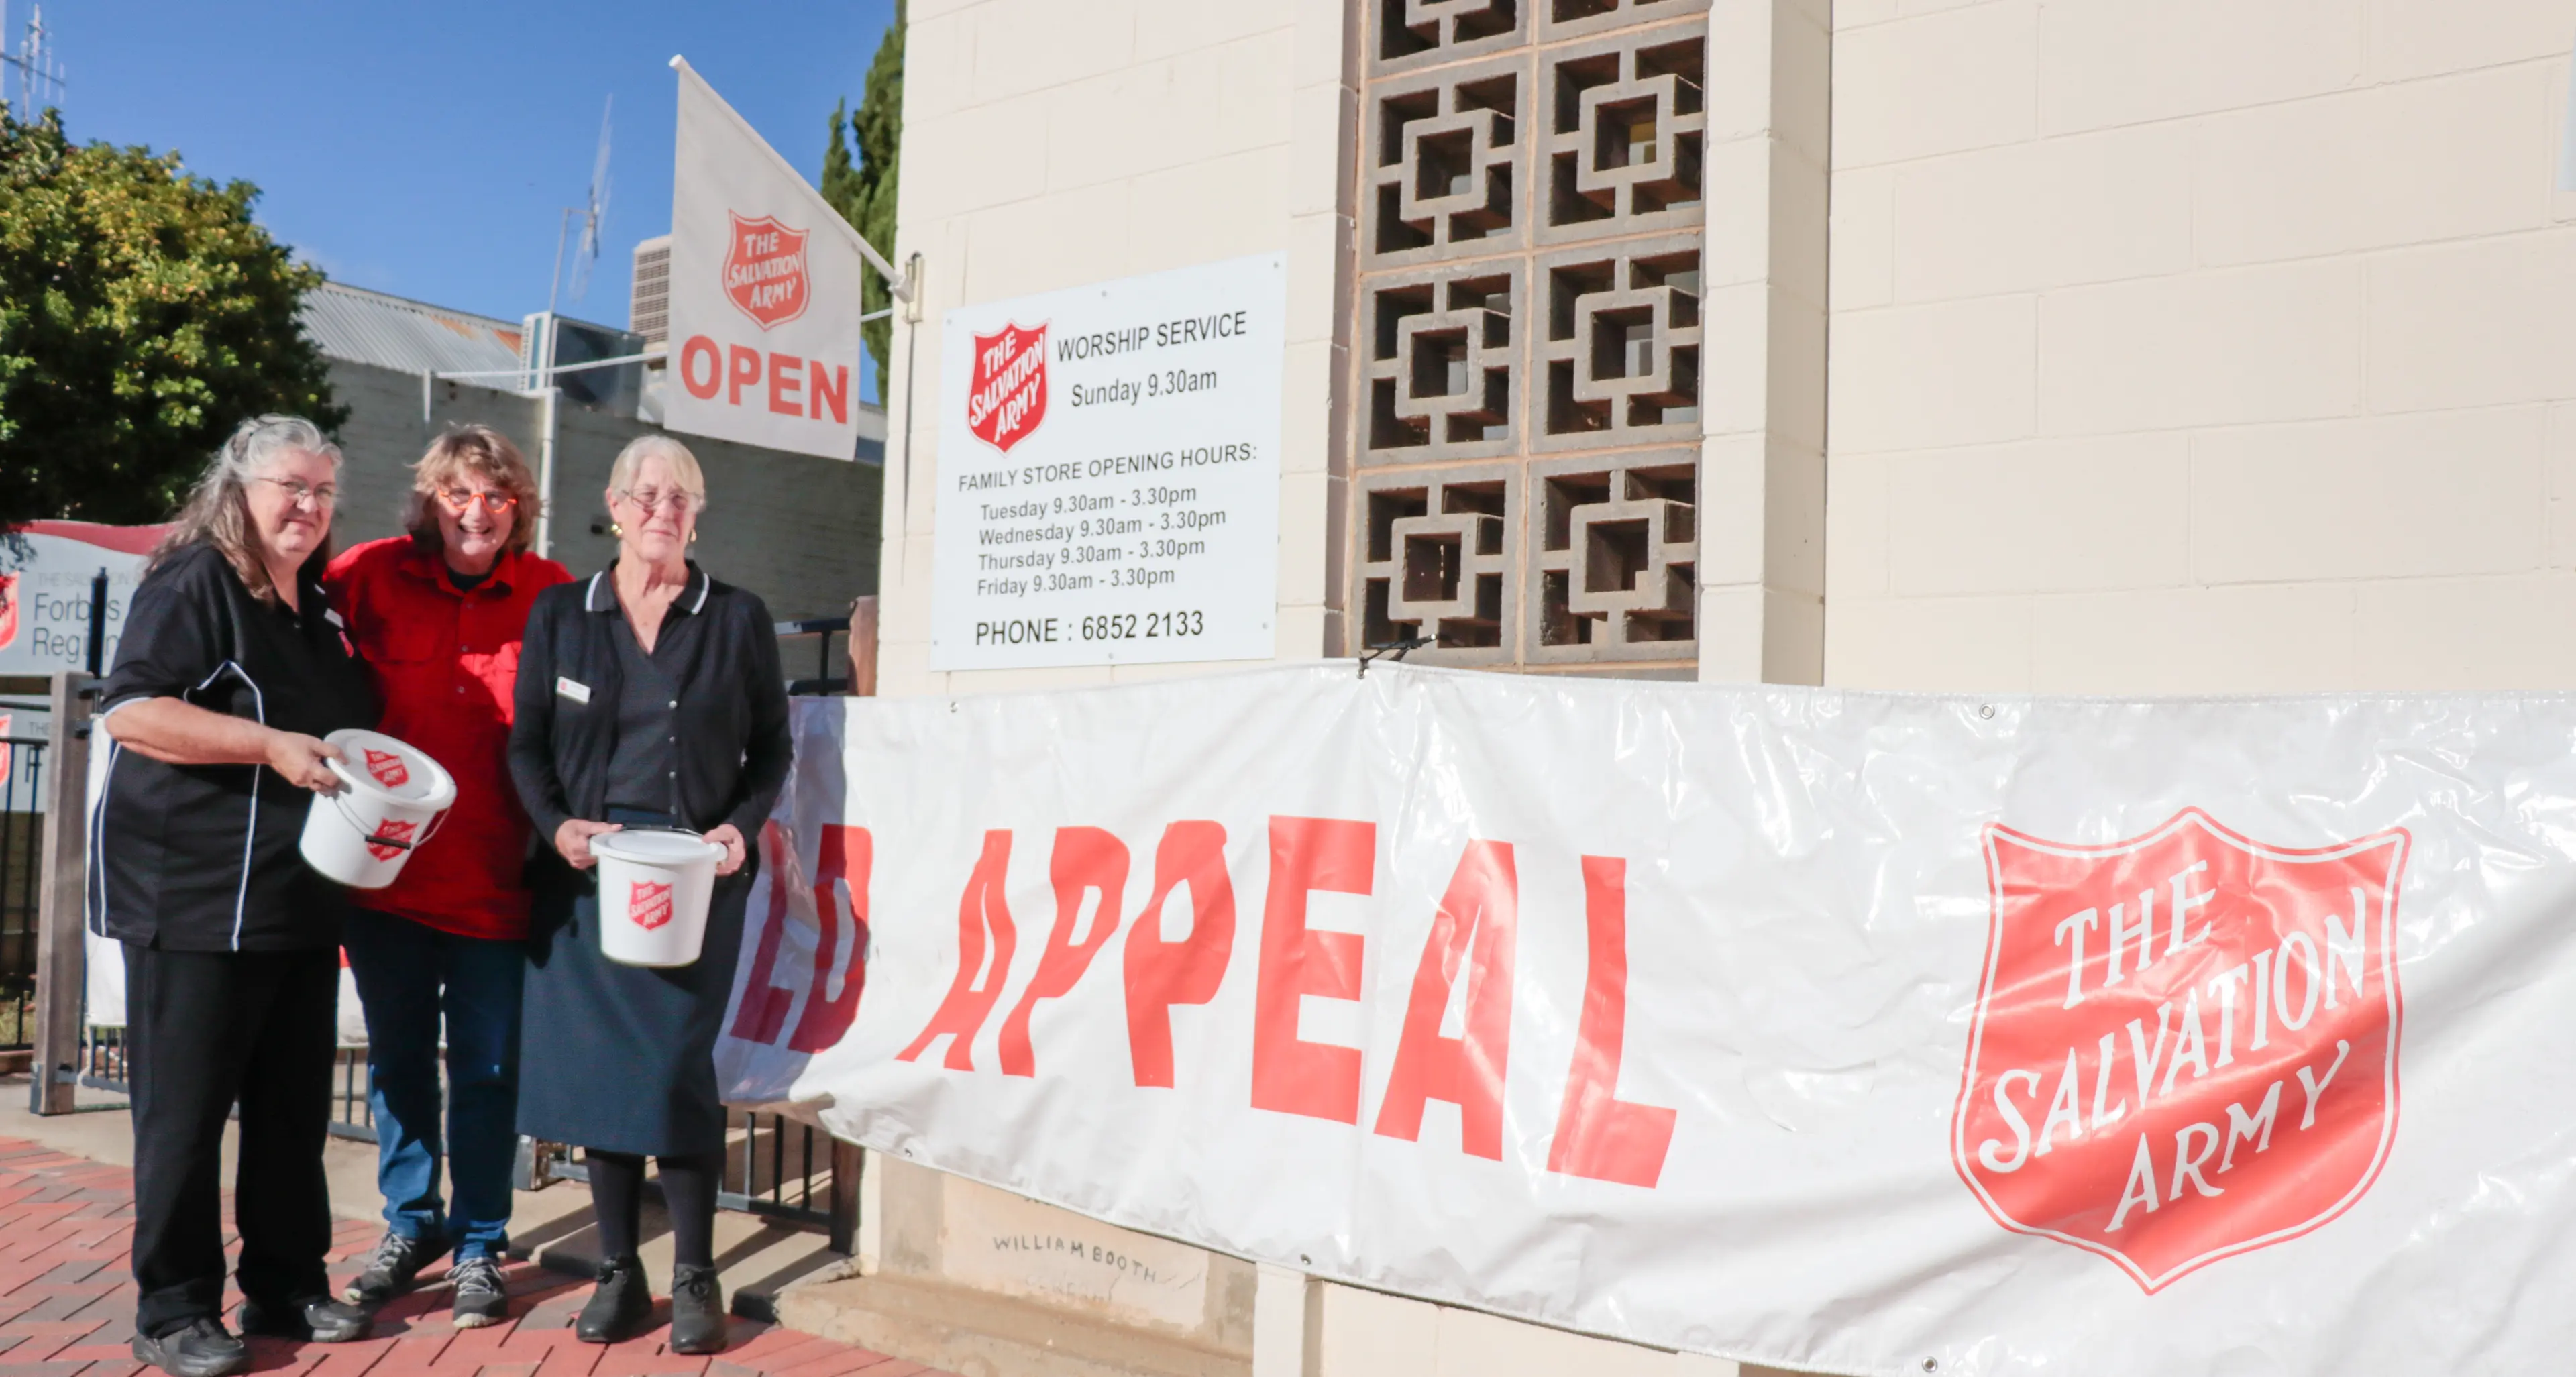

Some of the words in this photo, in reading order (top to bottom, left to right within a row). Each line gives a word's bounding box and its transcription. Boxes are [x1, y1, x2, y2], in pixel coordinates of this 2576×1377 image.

[743, 231, 780, 258] THE
[729, 251, 800, 288] SALVATION
[749, 276, 797, 309] ARMY
[983, 331, 1017, 379] THE
[1057, 326, 1150, 362] WORSHIP
[1156, 310, 1247, 347] SERVICE
[680, 335, 849, 424] OPEN
[970, 333, 1044, 427] SALVATION
[1071, 378, 1142, 408] Sunday
[1148, 368, 1217, 397] 9.30am
[994, 373, 1041, 443] ARMY
[959, 470, 1018, 492] FAMILY
[1023, 461, 1082, 485] STORE
[1088, 451, 1174, 478] OPENING
[1181, 443, 1257, 467] HOURS:
[981, 500, 1048, 520] Tuesday
[1053, 494, 1114, 514] 9.30am
[1132, 486, 1197, 508] 3.30pm
[979, 523, 1074, 545] Wednesday
[1080, 518, 1142, 537] 9.30am
[1161, 510, 1226, 532] 3.30pm
[978, 551, 1055, 570] Thursday
[1061, 545, 1122, 565] 9.30am
[1140, 539, 1205, 560] 3.30pm
[977, 578, 1028, 598] Friday
[1033, 573, 1093, 592] 9.30am
[1111, 567, 1175, 589] 3.30pm
[34, 592, 121, 622] Forbs
[976, 617, 1059, 646] PHONE
[1082, 613, 1137, 641] 6852
[1145, 610, 1204, 638] 2133
[32, 626, 119, 665] Regin
[2054, 859, 2216, 1010] THE
[894, 814, 1677, 1189] APPEAL
[1978, 887, 2367, 1173] SALVATION
[2104, 1039, 2349, 1233] ARMY
[993, 1235, 1085, 1258] WILLIAM
[1092, 1246, 1157, 1284] BOOTH
